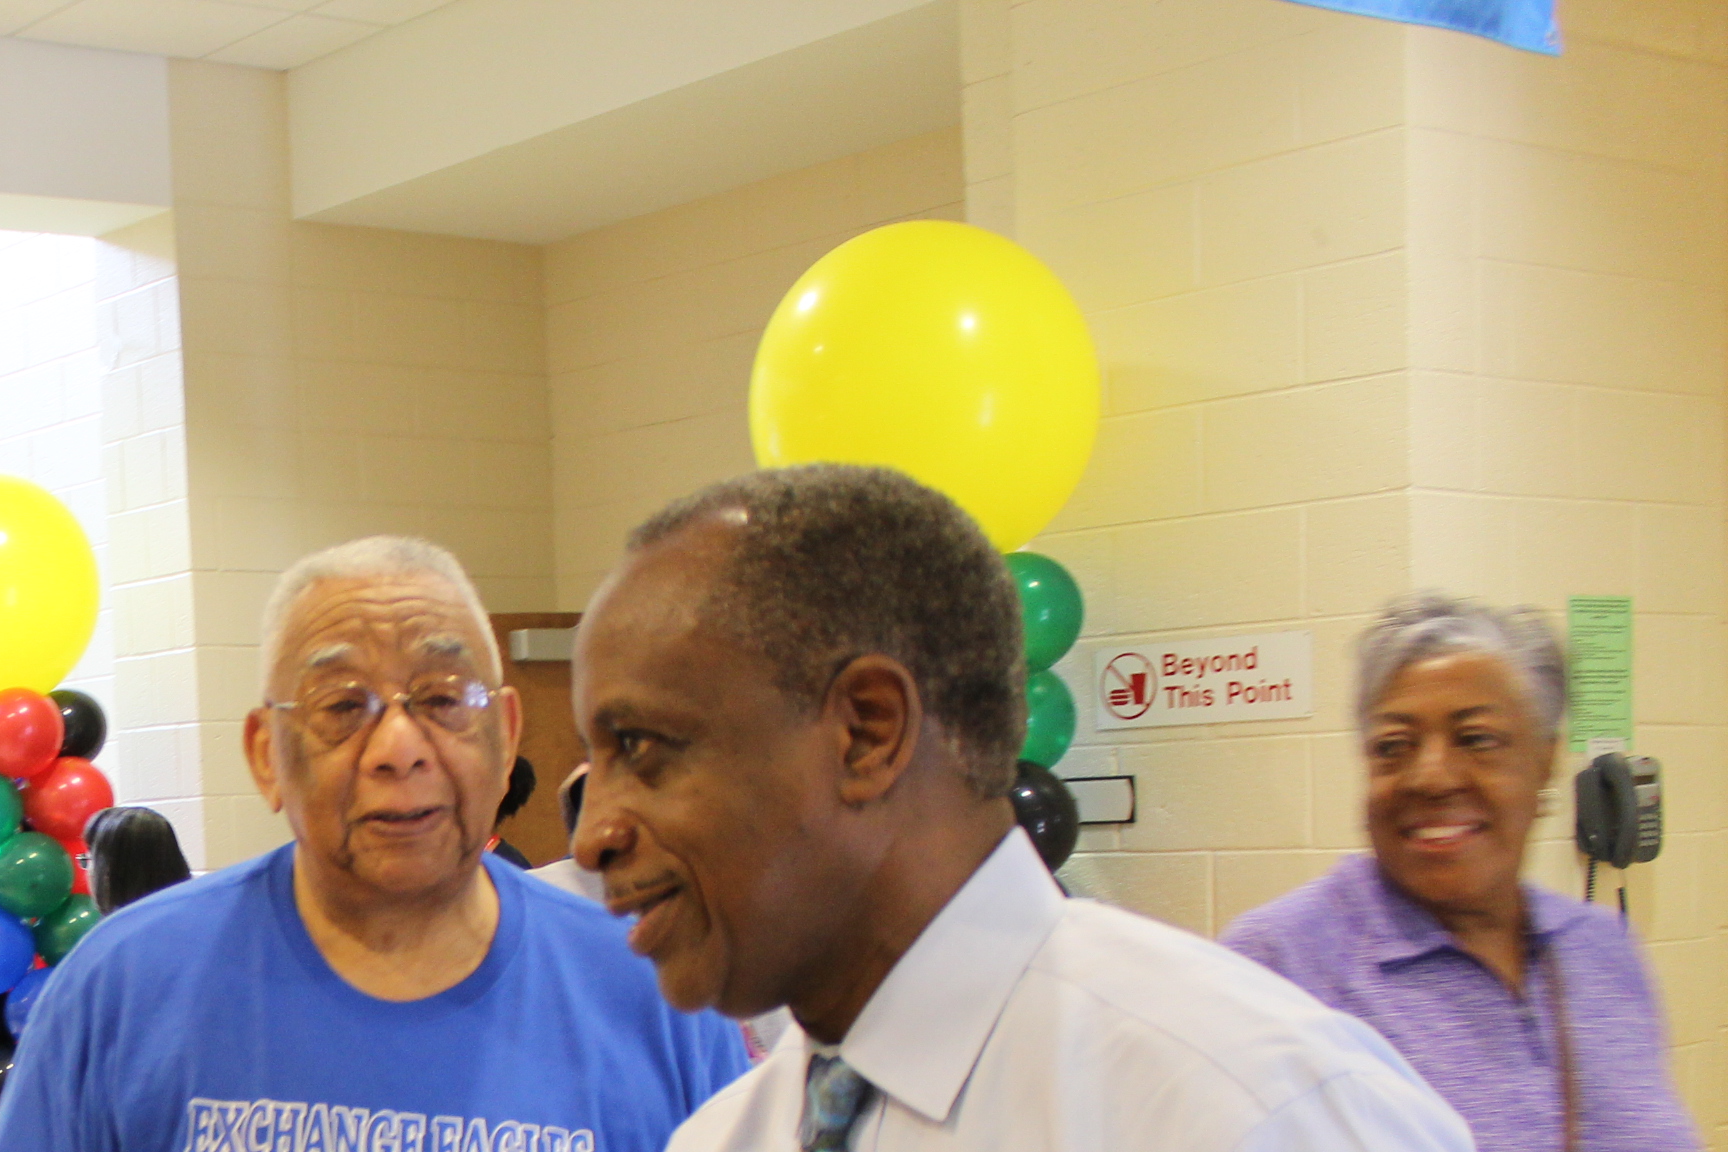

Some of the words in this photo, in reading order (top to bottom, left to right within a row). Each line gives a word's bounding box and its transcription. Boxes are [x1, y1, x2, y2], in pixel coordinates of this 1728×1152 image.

[1161, 646, 1259, 679] Beyond
[1163, 684, 1215, 709] This
[1226, 678, 1294, 706] Point
